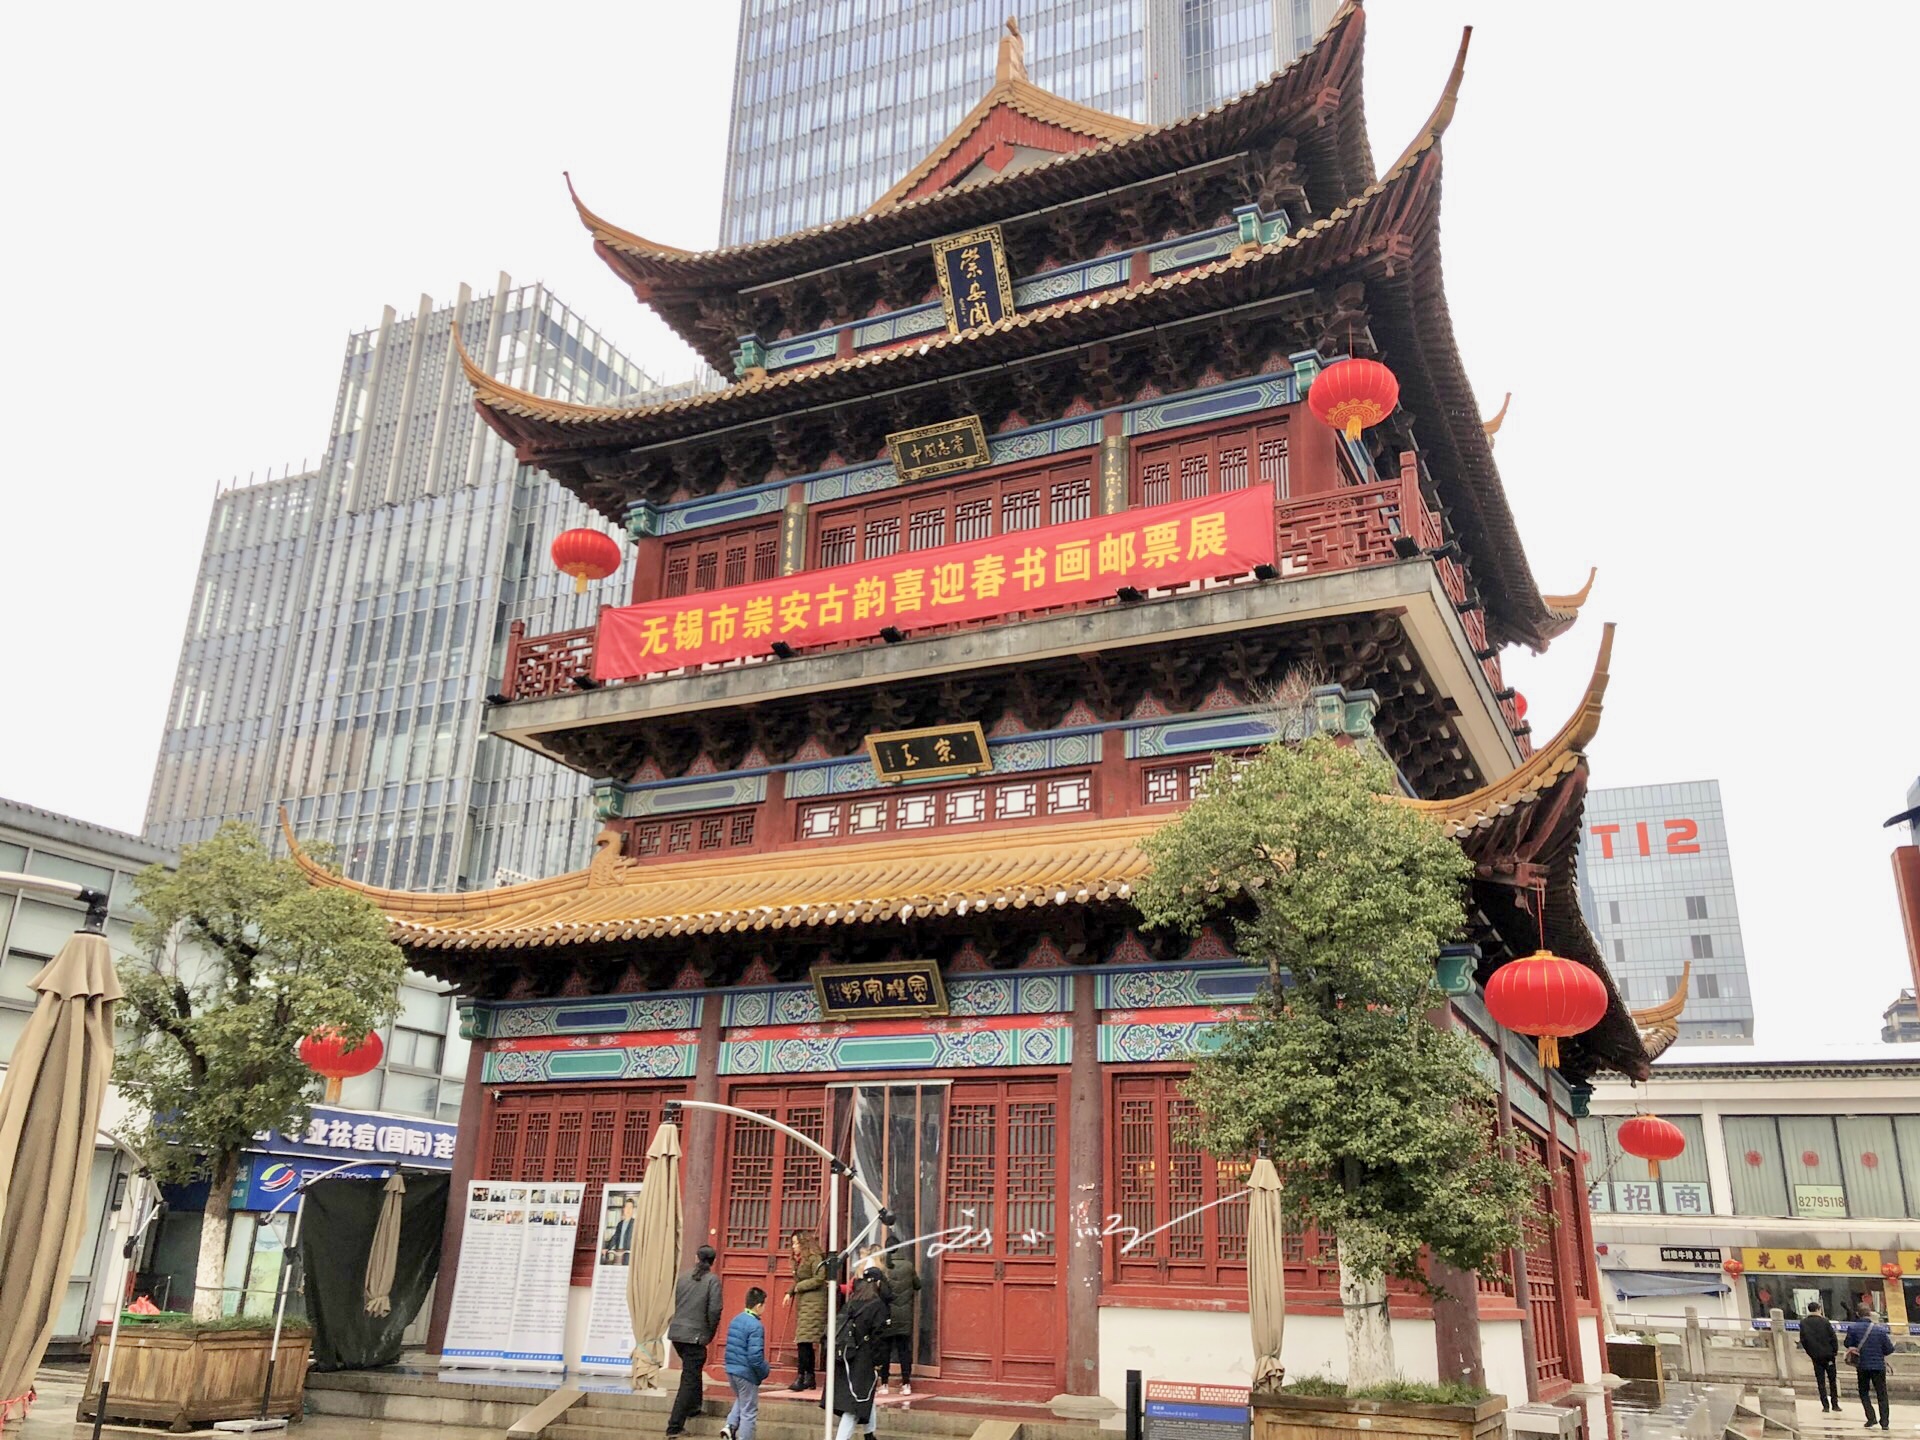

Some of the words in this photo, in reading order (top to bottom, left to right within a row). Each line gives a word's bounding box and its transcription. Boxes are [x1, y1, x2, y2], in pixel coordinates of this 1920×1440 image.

[639, 512, 1228, 658] 无锡市崇安古韵喜迎春书画邮票展
[1798, 1196, 1845, 1208] 82795118
[1758, 1252, 1867, 1271] 光明眼镜
